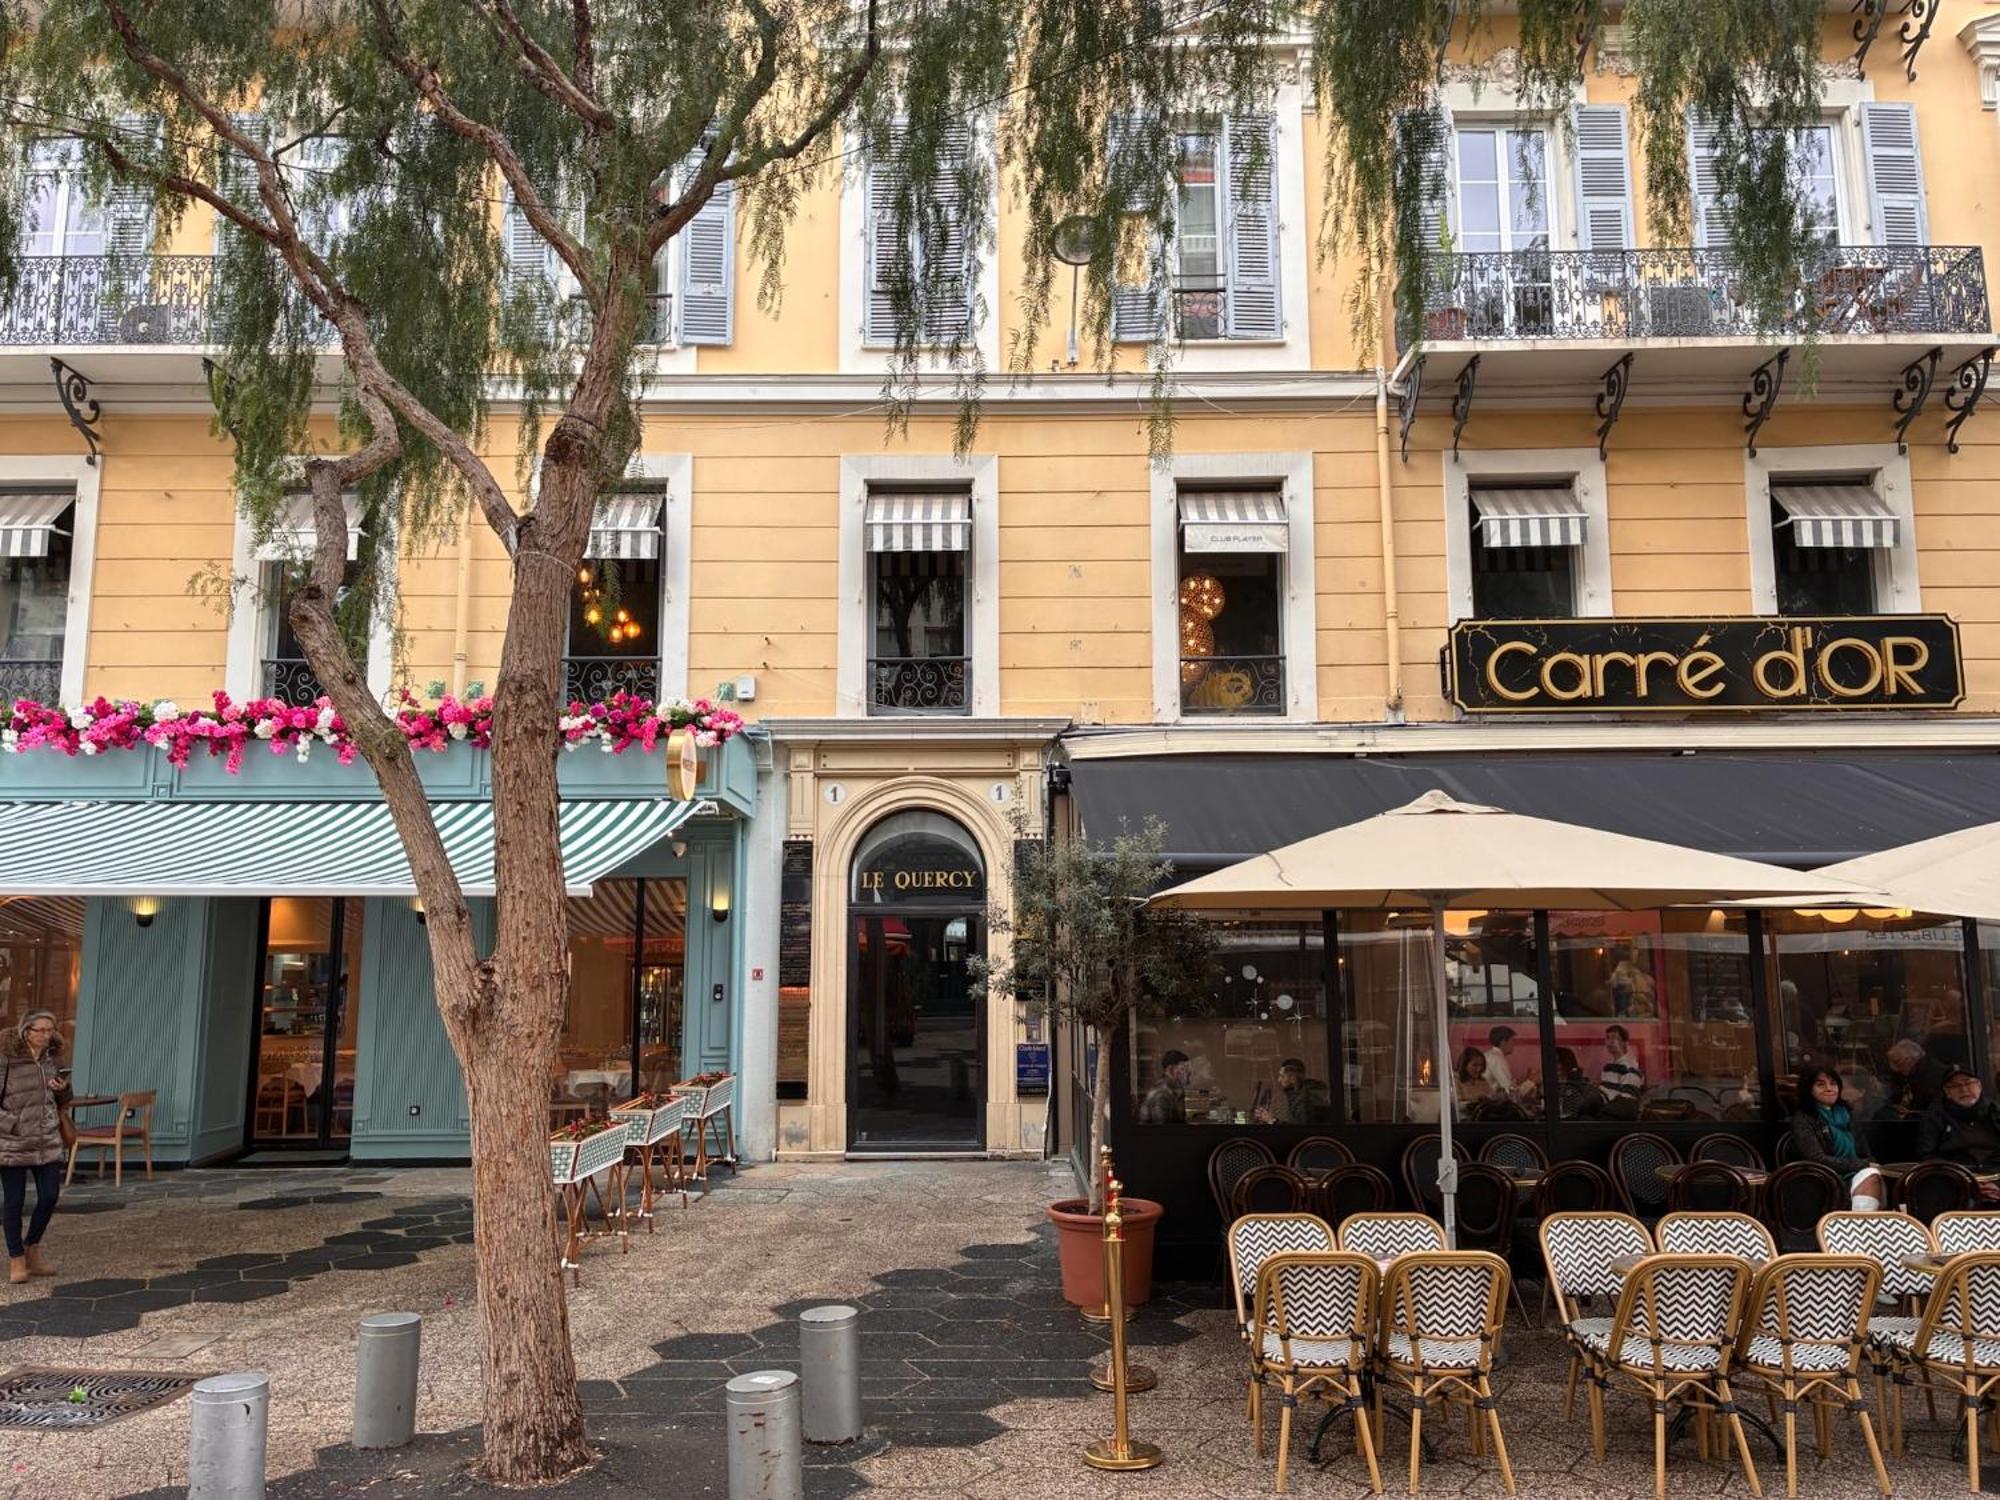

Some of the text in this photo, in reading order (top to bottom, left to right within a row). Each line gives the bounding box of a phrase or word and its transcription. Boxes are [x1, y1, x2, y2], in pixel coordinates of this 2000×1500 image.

[1486, 626, 1930, 700] Carré d'OR
[830, 786, 838, 802] 1
[995, 785, 1003, 801] 1
[862, 871, 977, 890] LE QUERCY
